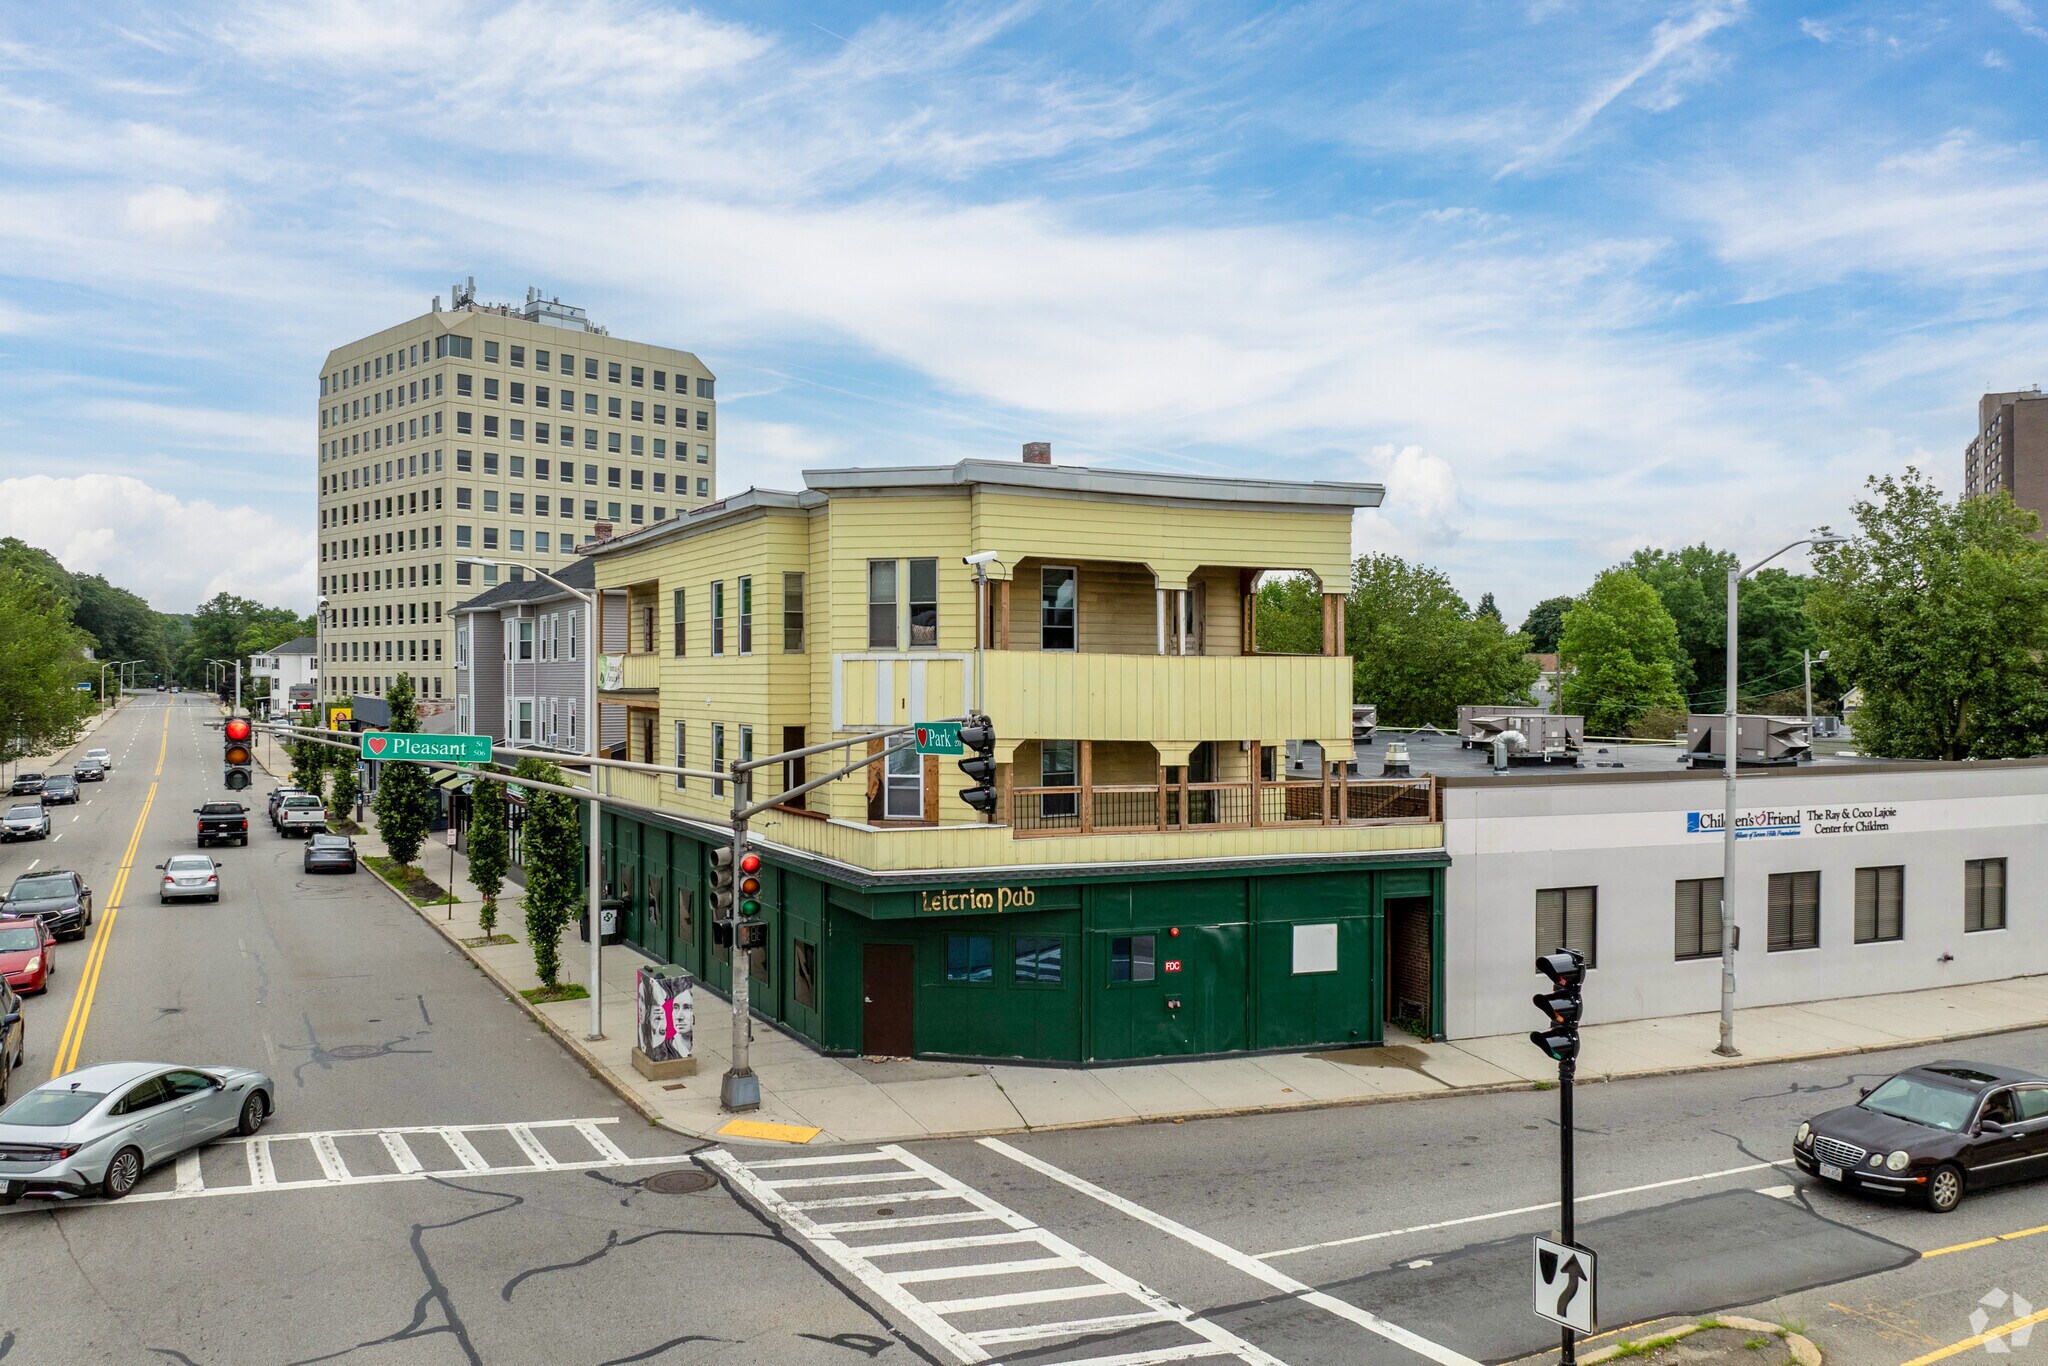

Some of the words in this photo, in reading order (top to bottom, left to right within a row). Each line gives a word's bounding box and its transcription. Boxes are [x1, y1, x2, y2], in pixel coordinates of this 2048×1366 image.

[928, 728, 952, 747] Park
[392, 738, 467, 756] Pleasant
[1700, 812, 1754, 829] Chilen's
[1766, 810, 1801, 825] Friend
[1807, 810, 1823, 821] The
[1825, 809, 1840, 821] Ray
[1842, 808, 1850, 819] &
[1852, 807, 1872, 819] Coco
[1874, 807, 1897, 819] Lajoie
[1814, 823, 1841, 834] Center
[1843, 822, 1854, 833] for
[1855, 820, 1889, 832] Children
[922, 888, 993, 912] Leitrim
[998, 886, 1035, 913] Pub
[1165, 961, 1180, 971] FDC
